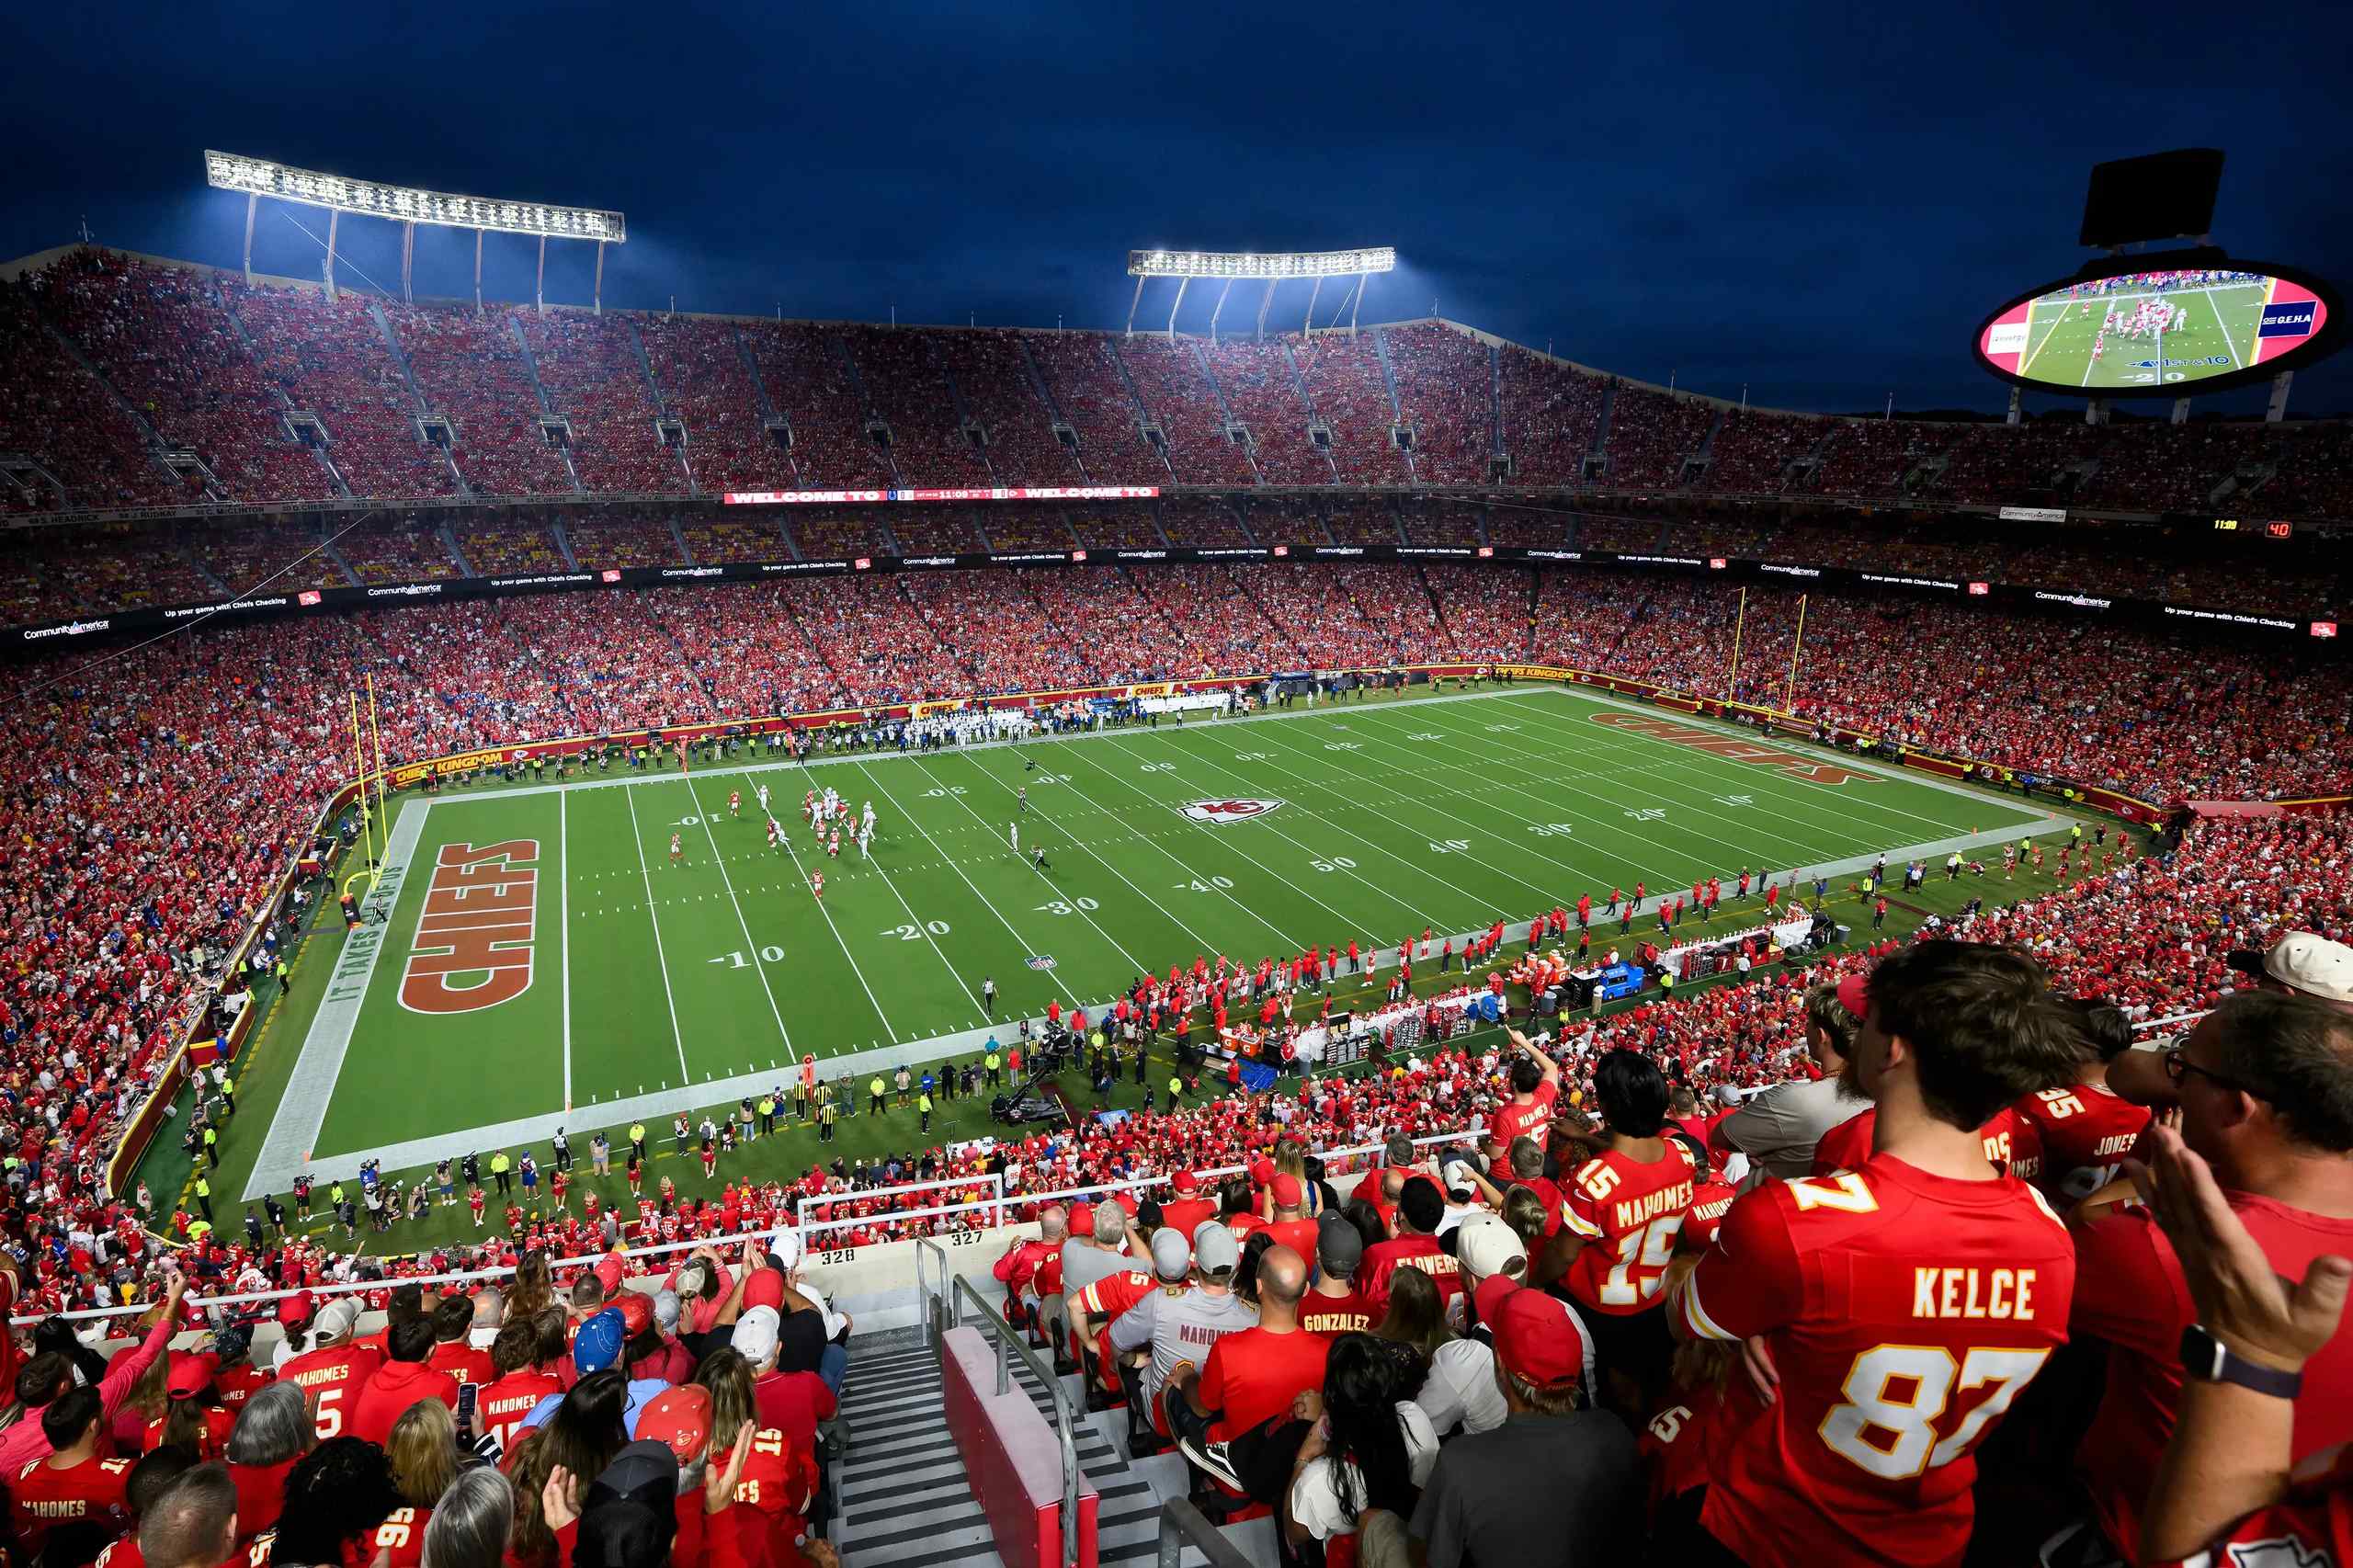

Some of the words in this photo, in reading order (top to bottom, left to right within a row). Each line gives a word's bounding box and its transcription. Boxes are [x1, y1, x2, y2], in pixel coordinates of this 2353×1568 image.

[732, 492, 846, 504] WELCOME
[847, 491, 881, 502] TO
[1026, 488, 1122, 498] WELCOME
[1124, 487, 1152, 497] TO
[2214, 520, 2237, 530] 11:09
[2269, 524, 2290, 536] 40
[194, 607, 214, 616] game
[215, 602, 233, 611] with
[2258, 619, 2295, 629] Checking
[1527, 668, 1565, 680] KINGDO
[1134, 686, 1165, 696] CHIEFS
[1587, 712, 1889, 786] CHIEFS
[437, 752, 503, 773] KINGDOM
[1528, 824, 1570, 837] 30
[1427, 839, 1469, 855] 40
[1309, 856, 1358, 873] 50
[1189, 875, 1233, 893] 40
[1047, 896, 1099, 916] 30
[397, 838, 540, 1015] CHIEFS
[895, 919, 951, 941] 20
[337, 931, 380, 980] TAKES
[727, 946, 785, 970] 10
[2093, 1132, 2137, 1157] JONES
[1575, 1158, 1622, 1200] 15
[1615, 1179, 1693, 1229] MAHOMES
[951, 1231, 983, 1246] 327
[822, 1249, 855, 1265] 328
[1599, 1214, 1690, 1306] 15
[1912, 1267, 2037, 1321] KELCE
[294, 1365, 349, 1388] MAHOMES
[487, 1394, 538, 1415] MAHOMES
[1818, 1343, 2052, 1481] 87
[754, 1427, 783, 1457] 15
[22, 1500, 87, 1520] MAHOMES
